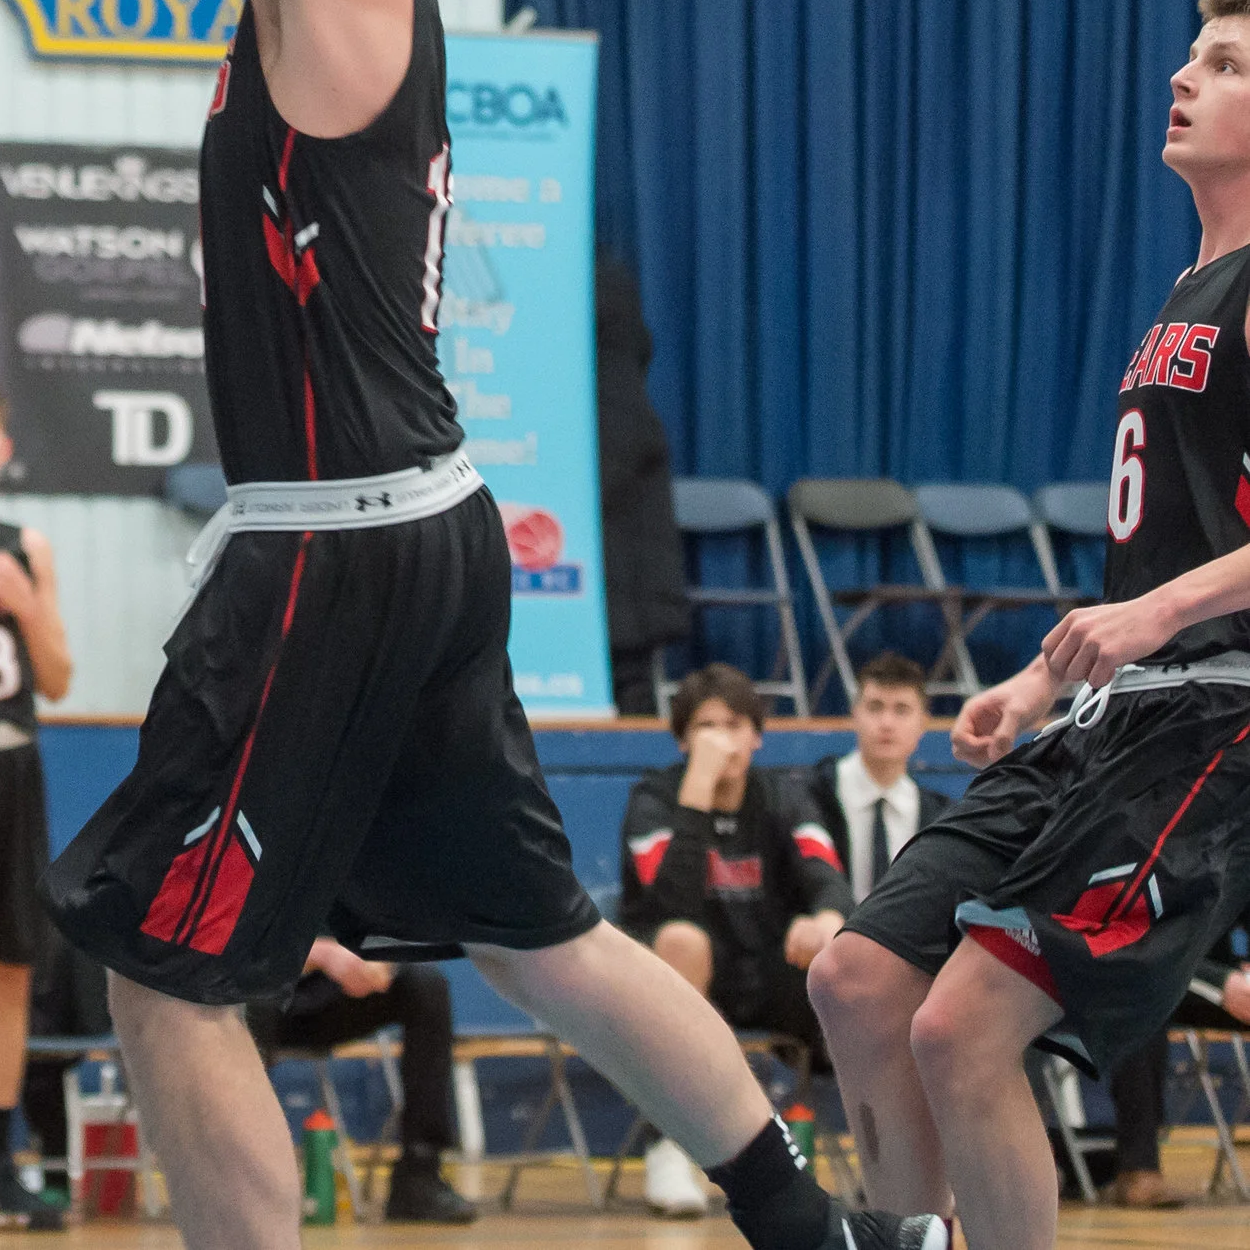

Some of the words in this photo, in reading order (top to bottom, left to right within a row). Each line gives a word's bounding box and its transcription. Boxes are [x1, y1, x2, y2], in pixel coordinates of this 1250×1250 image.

[421, 142, 454, 334] 1
[93, 390, 193, 467] TD
[1107, 407, 1146, 544] 6
